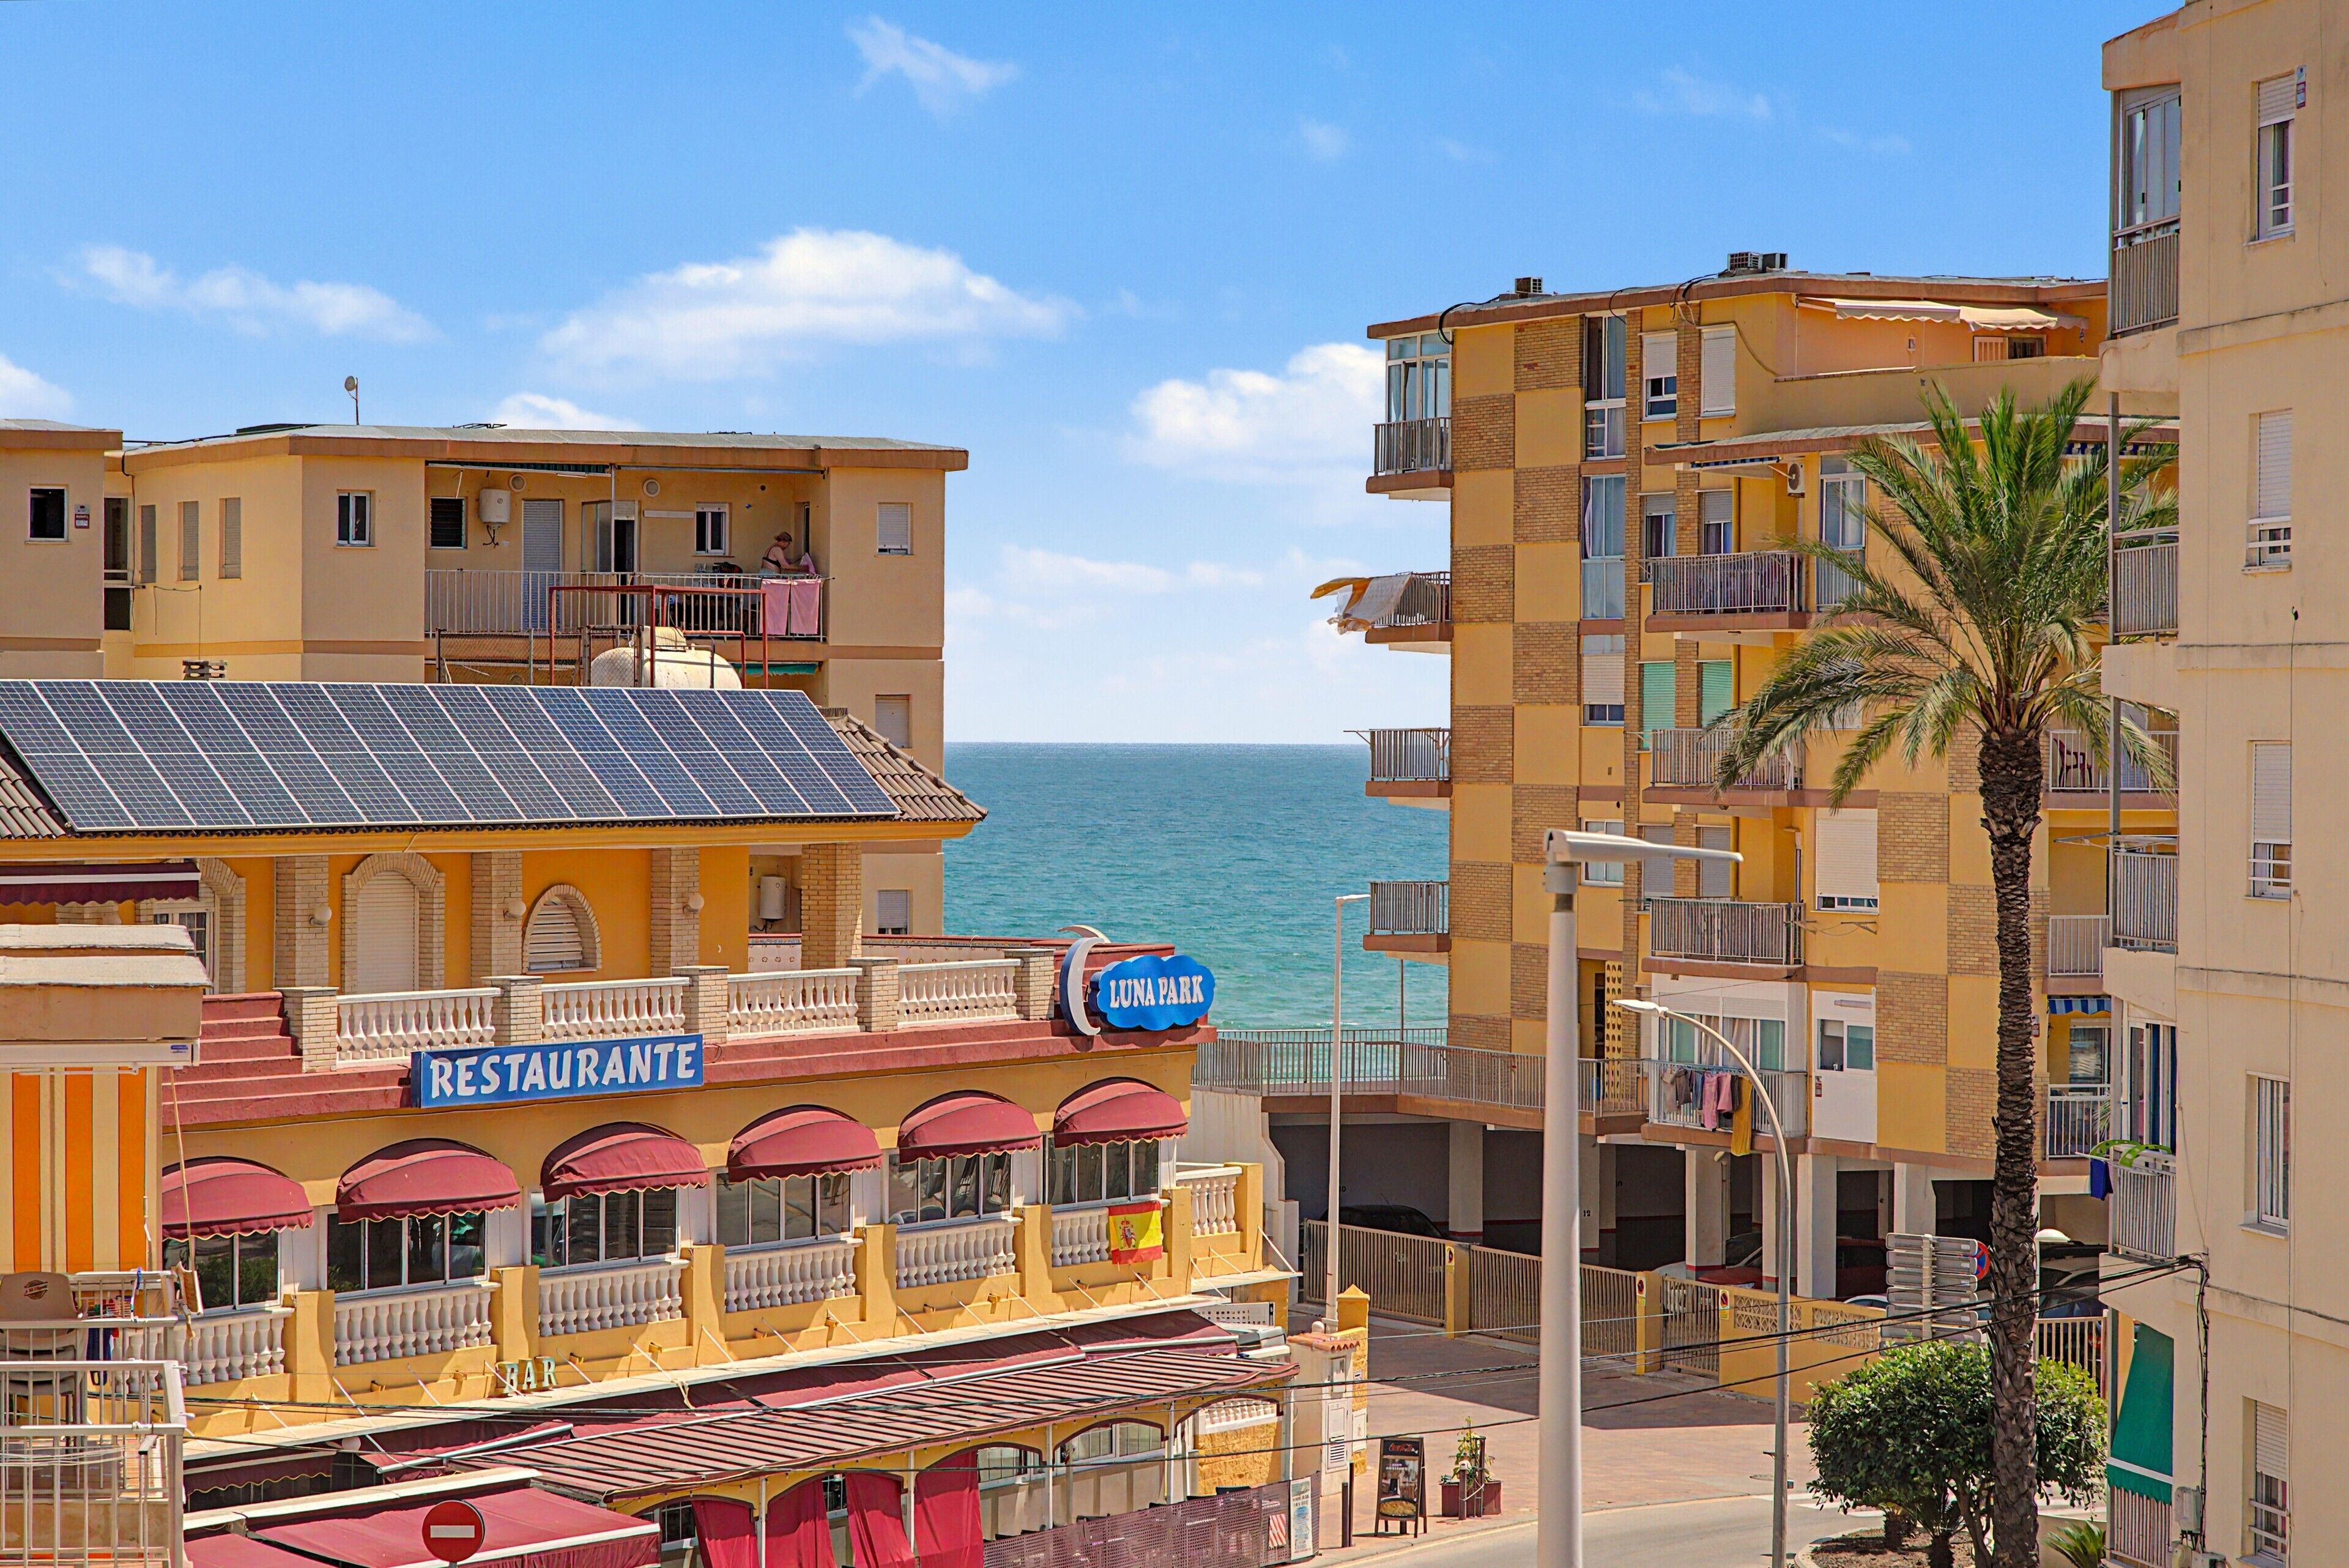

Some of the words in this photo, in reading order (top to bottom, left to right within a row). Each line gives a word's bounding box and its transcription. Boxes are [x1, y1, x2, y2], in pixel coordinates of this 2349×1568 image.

[1110, 978, 1156, 1008] LUNA
[1158, 975, 1204, 1005] PARK
[430, 1042, 697, 1099] RESTAURANTE
[502, 1357, 557, 1394] BAR
